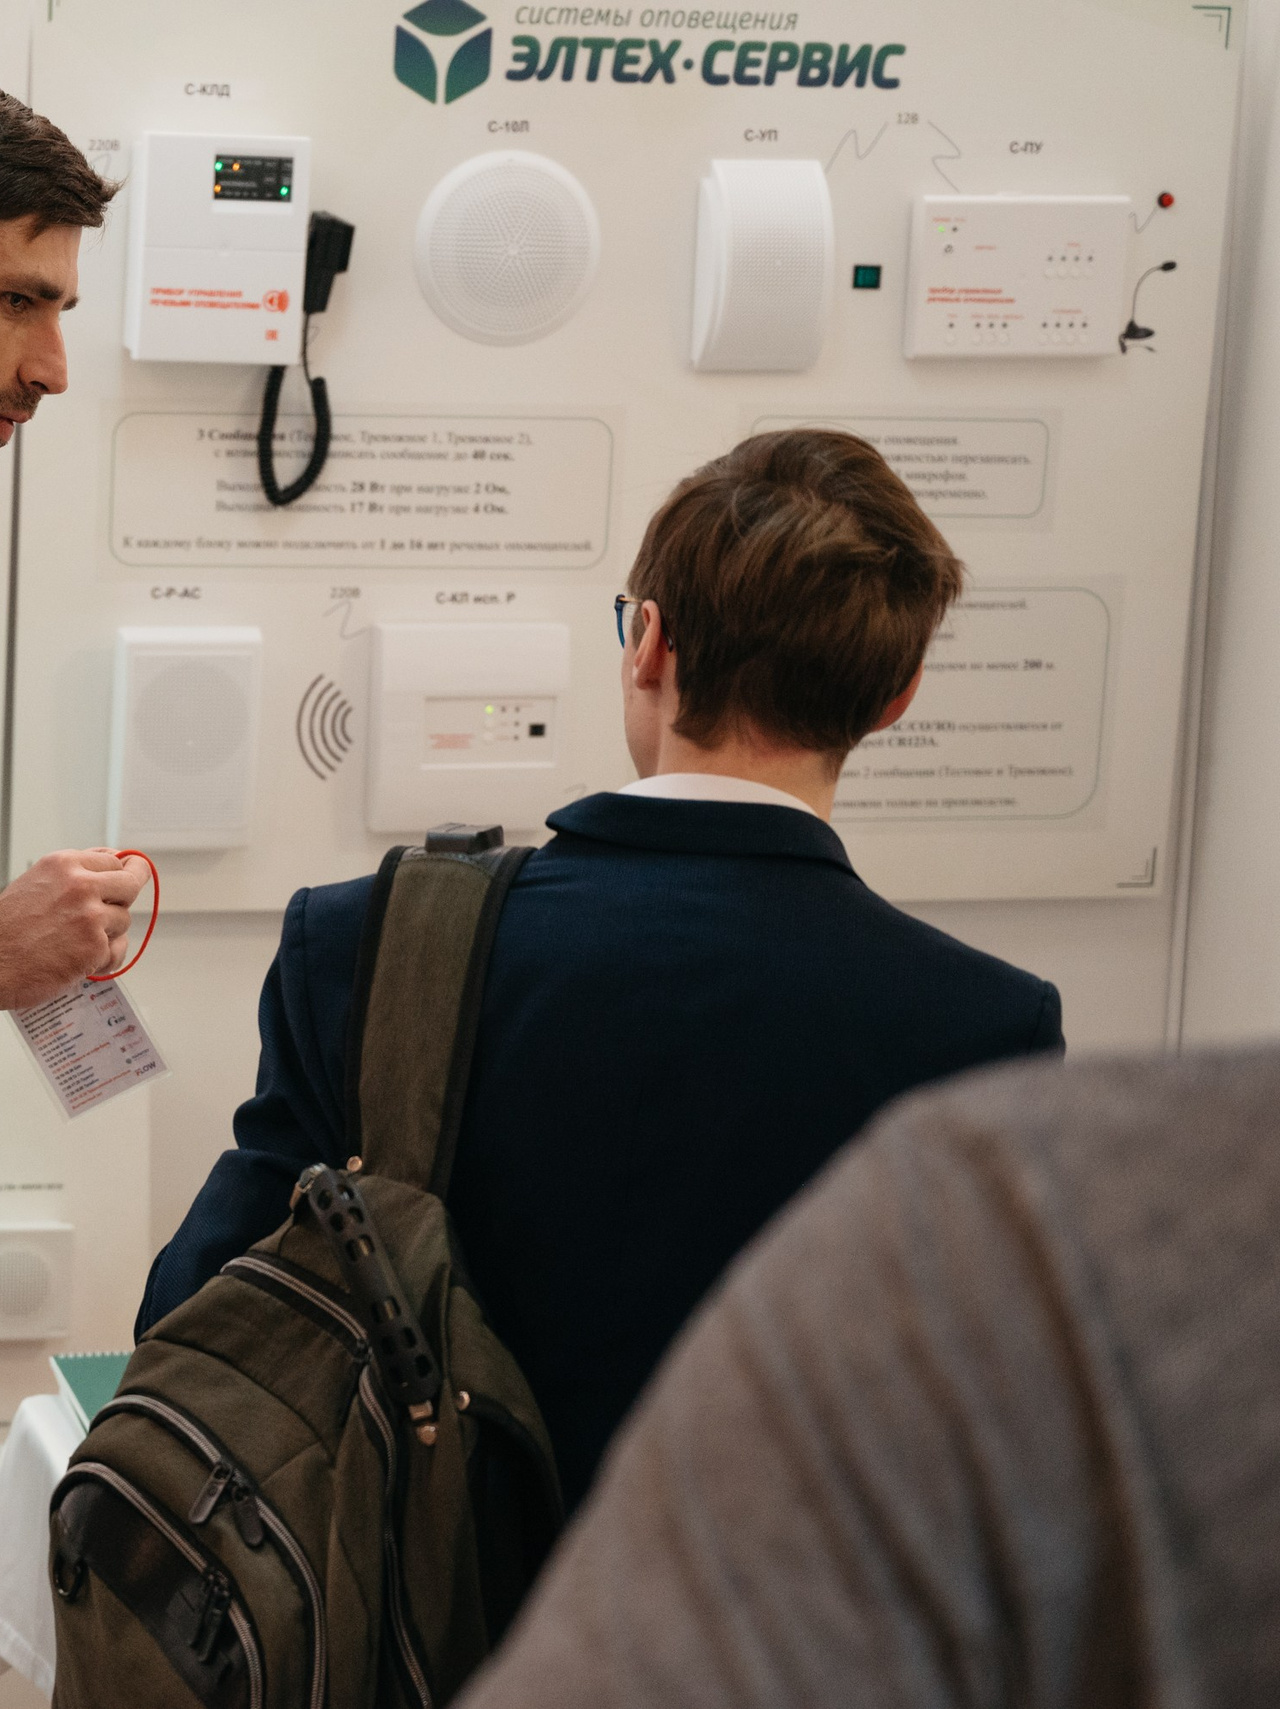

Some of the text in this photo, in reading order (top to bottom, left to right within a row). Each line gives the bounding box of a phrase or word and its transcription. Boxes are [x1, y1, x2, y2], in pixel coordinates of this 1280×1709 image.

[515, 4, 799, 33] системы оповещения
[135, 1060, 157, 1077] FLOW
